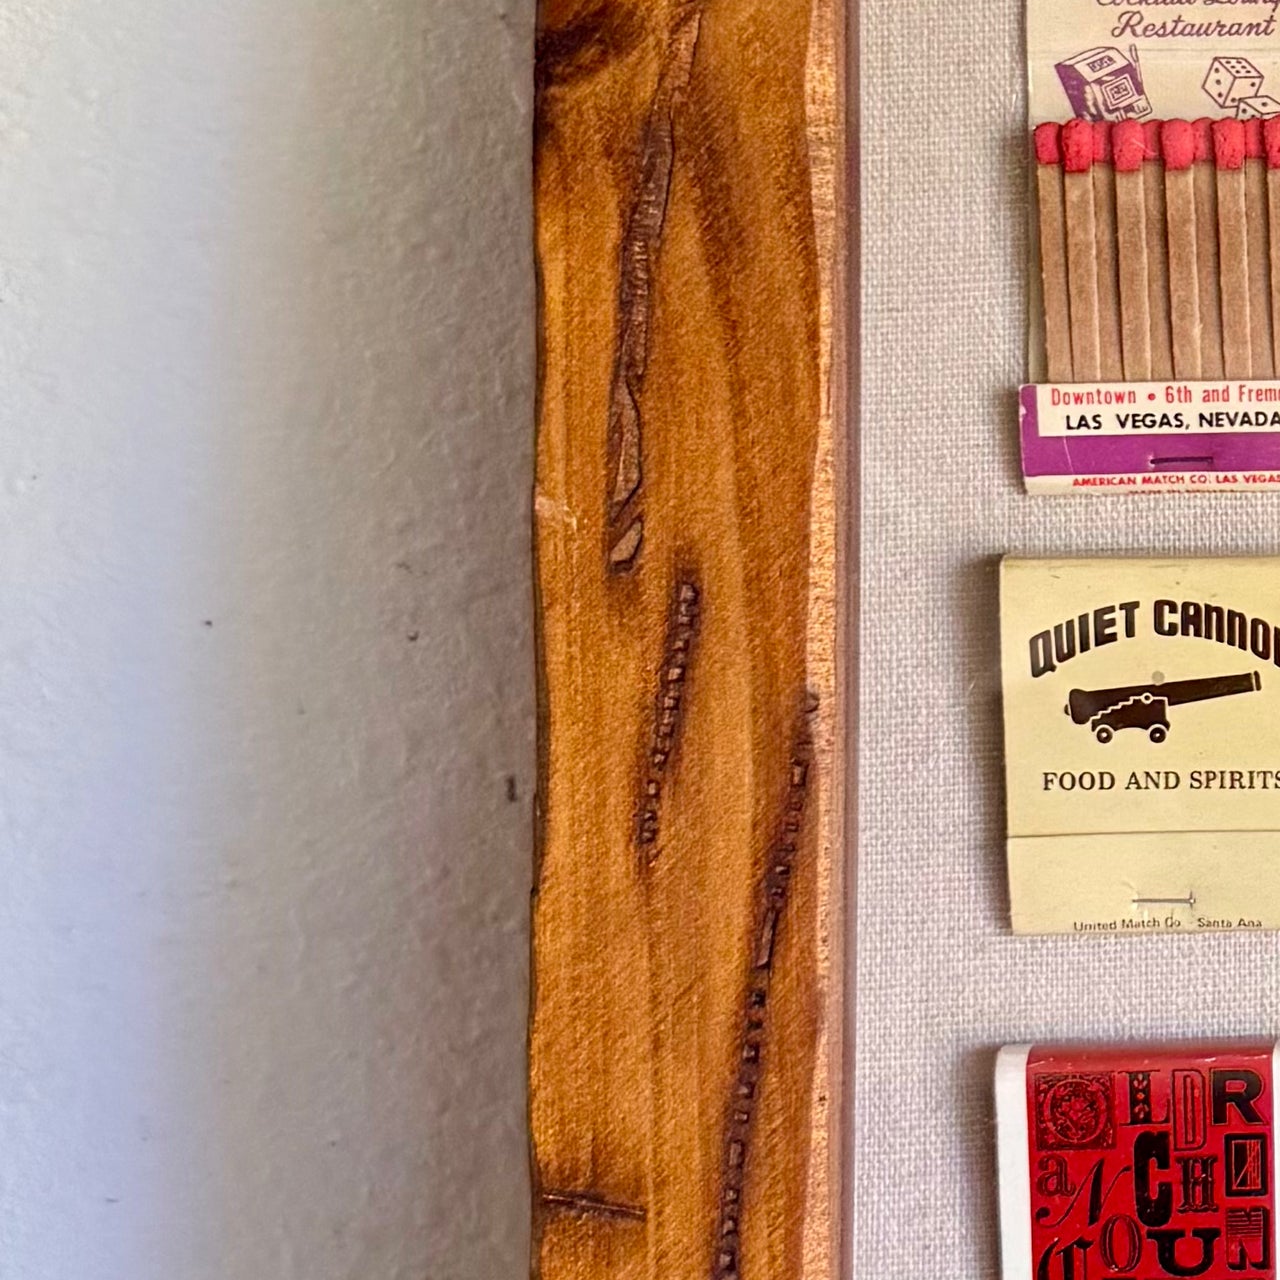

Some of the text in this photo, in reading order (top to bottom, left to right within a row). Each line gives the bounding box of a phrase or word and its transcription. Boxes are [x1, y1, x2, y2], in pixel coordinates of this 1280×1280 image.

[1111, 11, 1277, 38] Restaurant
[1051, 387, 1136, 406] Downtown
[1165, 386, 1192, 403] 6th
[1203, 385, 1230, 402] and
[1066, 414, 1102, 430] LAS
[1116, 412, 1190, 429] VEGAS,
[1073, 477, 1136, 486] AMERICAN
[1142, 475, 1184, 484] MATCH
[1216, 474, 1238, 483] LAS
[1029, 600, 1141, 678] QUIET
[1043, 772, 1116, 791] FOOD
[1125, 771, 1180, 790] AND
